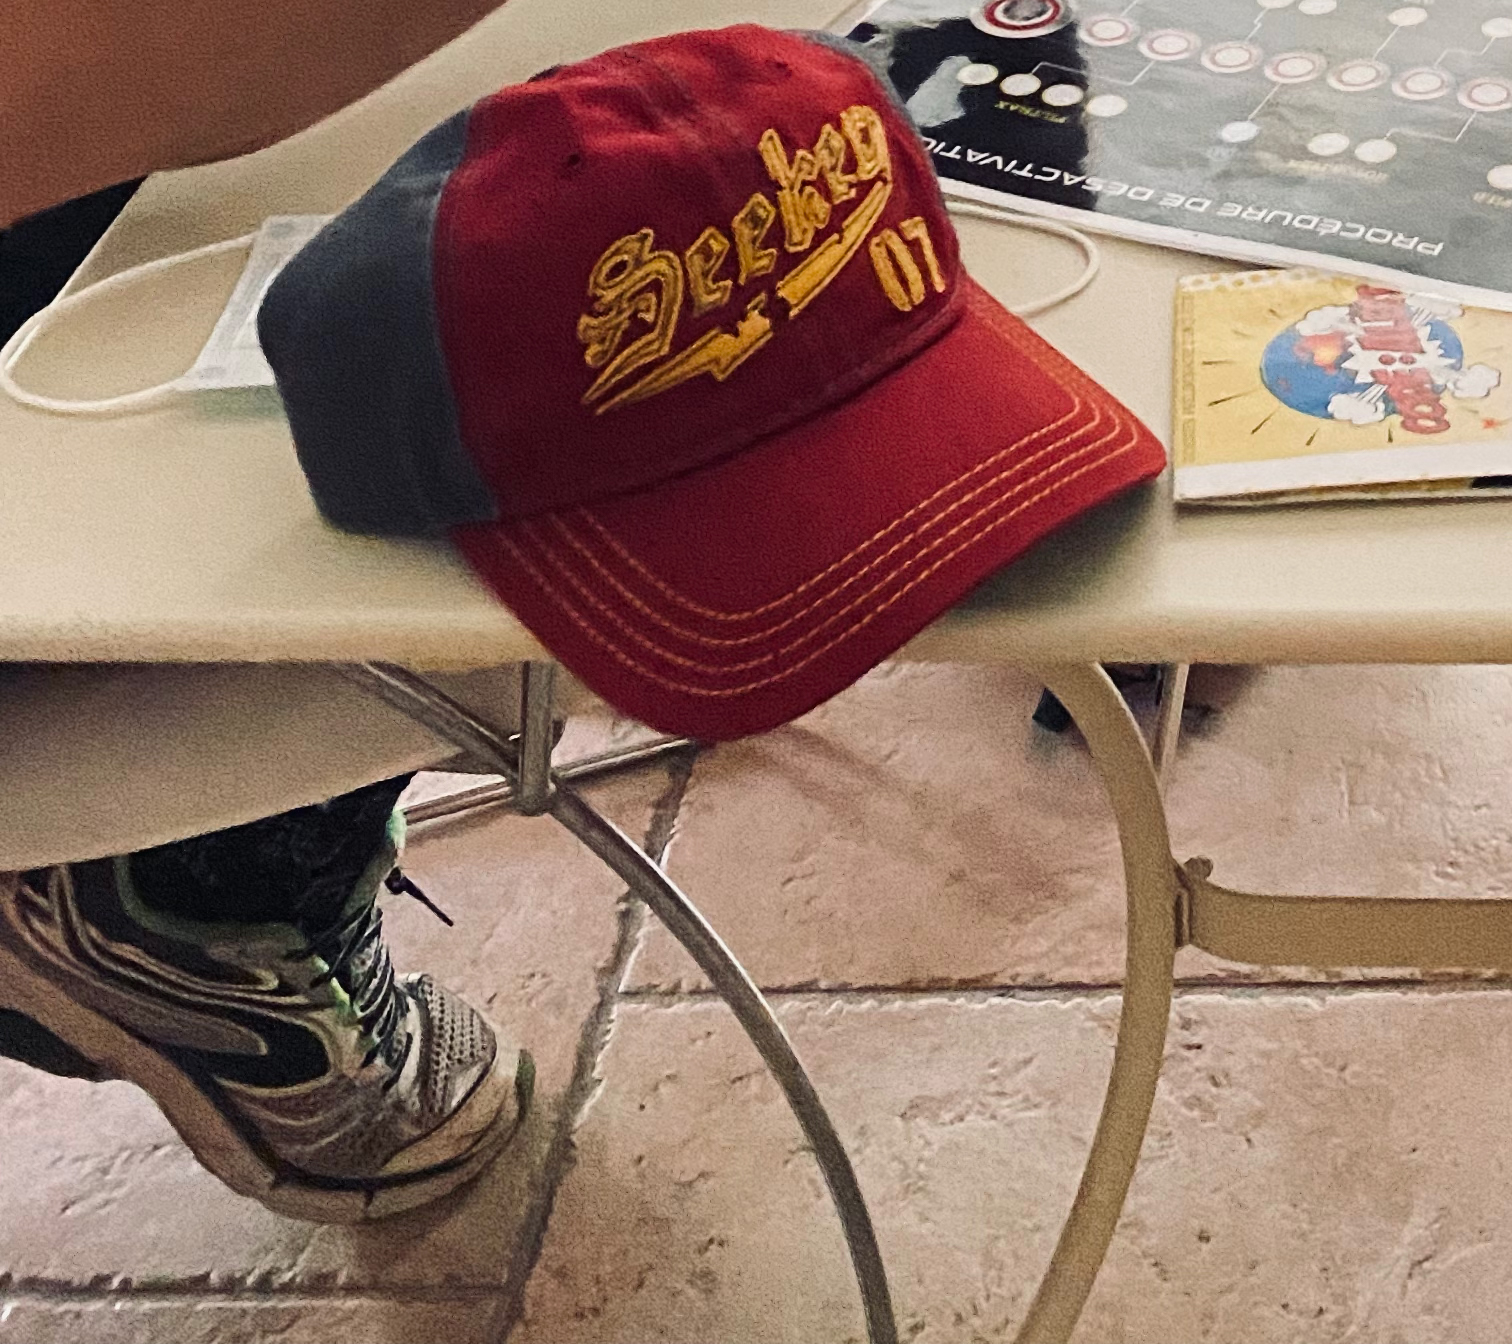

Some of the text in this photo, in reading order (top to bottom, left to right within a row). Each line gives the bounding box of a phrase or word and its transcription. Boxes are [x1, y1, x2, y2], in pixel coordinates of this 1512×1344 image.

[1157, 192, 1214, 213] DE
[1215, 200, 1446, 257] PROCÉDURE
[869, 216, 947, 312] 07
